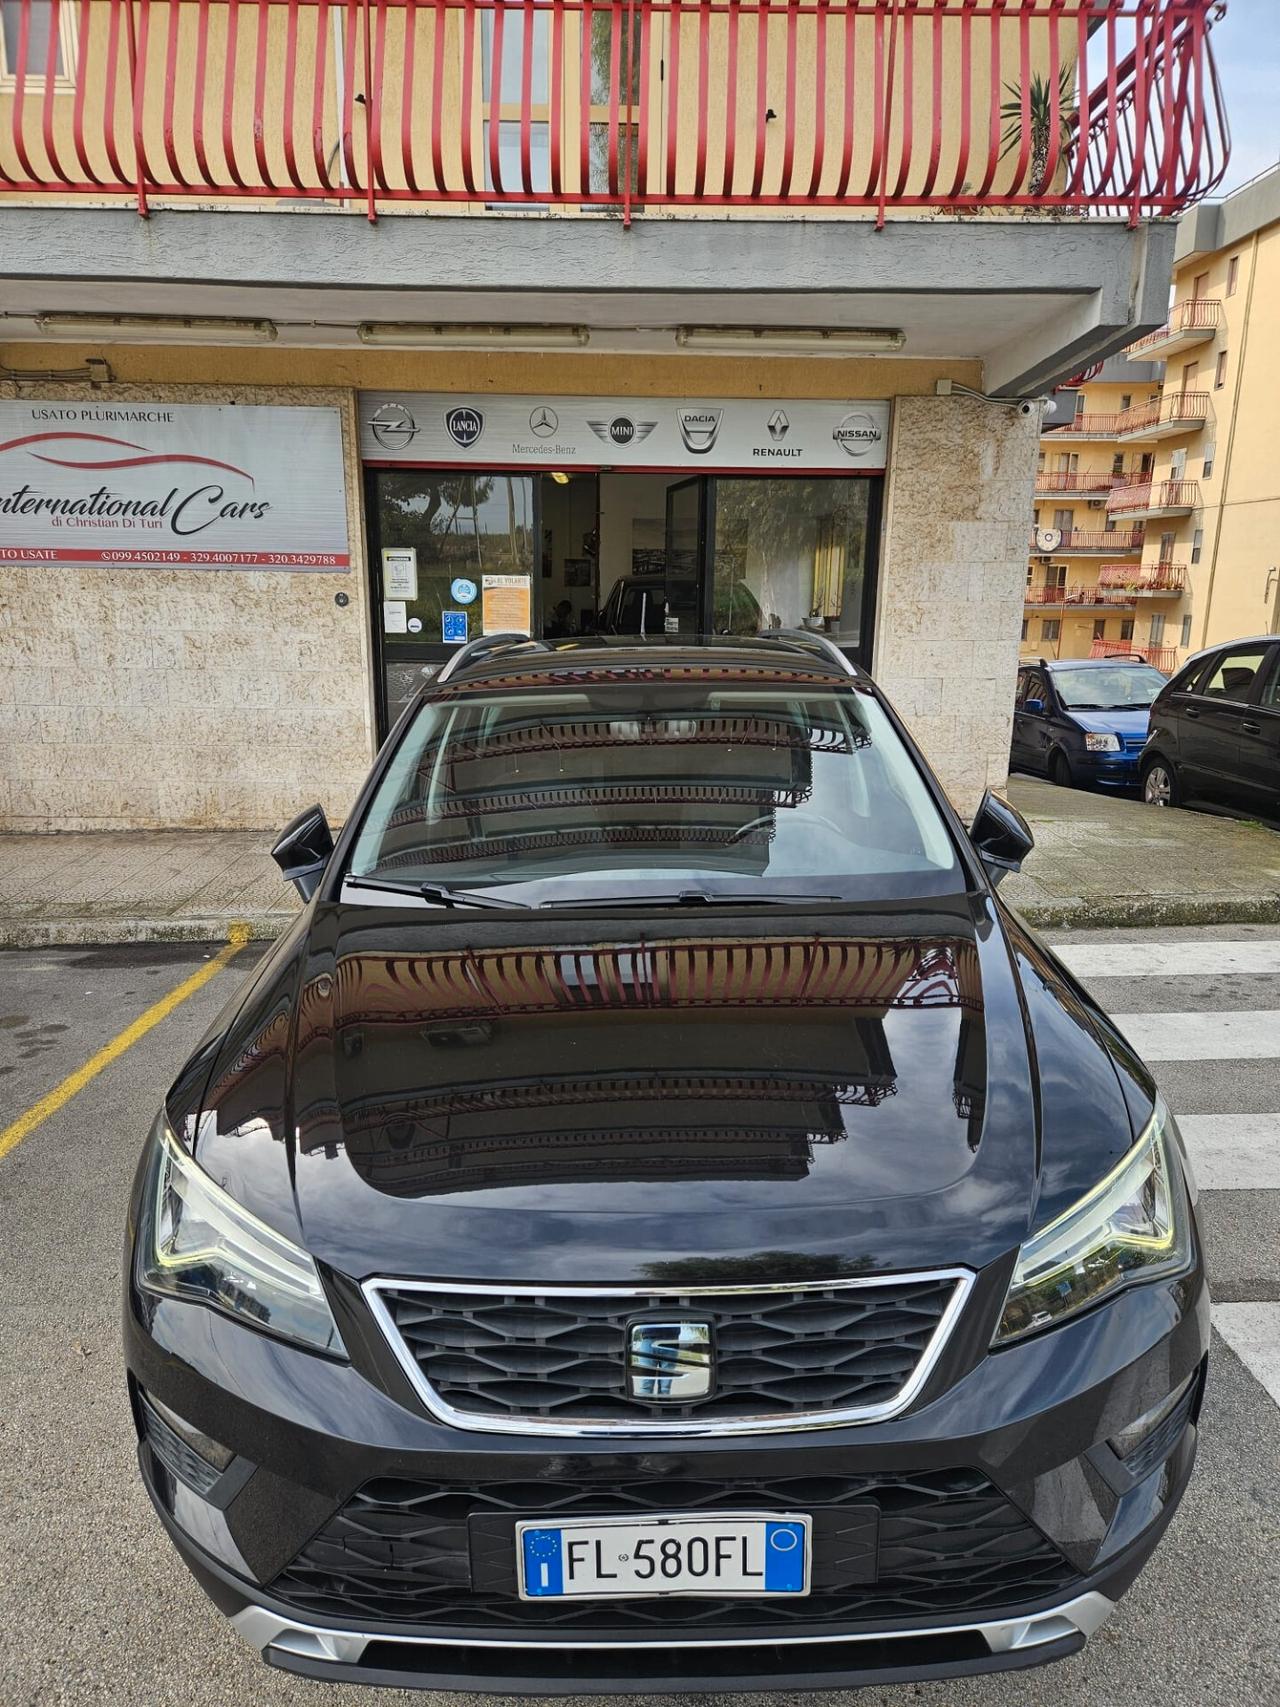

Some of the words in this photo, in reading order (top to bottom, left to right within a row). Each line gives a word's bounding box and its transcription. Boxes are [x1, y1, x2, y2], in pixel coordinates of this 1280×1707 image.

[31, 409, 77, 421] USATO
[81, 410, 175, 423] PLURIMARCHE
[684, 415, 716, 423] DACIA
[452, 420, 479, 433] LANCIA
[610, 425, 634, 437] MINI
[837, 429, 877, 439] NISSAN
[512, 444, 576, 455] Mercedes-Benz
[753, 448, 803, 457] RENAULT
[171, 484, 273, 536] Cars
[51, 515, 63, 527] di
[66, 517, 119, 528] Christian
[122, 518, 136, 528] Di
[139, 518, 163, 529] Turi
[20, 549, 58, 560] USATE
[111, 551, 181, 562] 099.4502149
[190, 552, 258, 563] 329.4007177
[268, 553, 336, 565] 320.3429788
[567, 1539, 618, 1580] FL
[633, 1536, 764, 1579] 580FL
